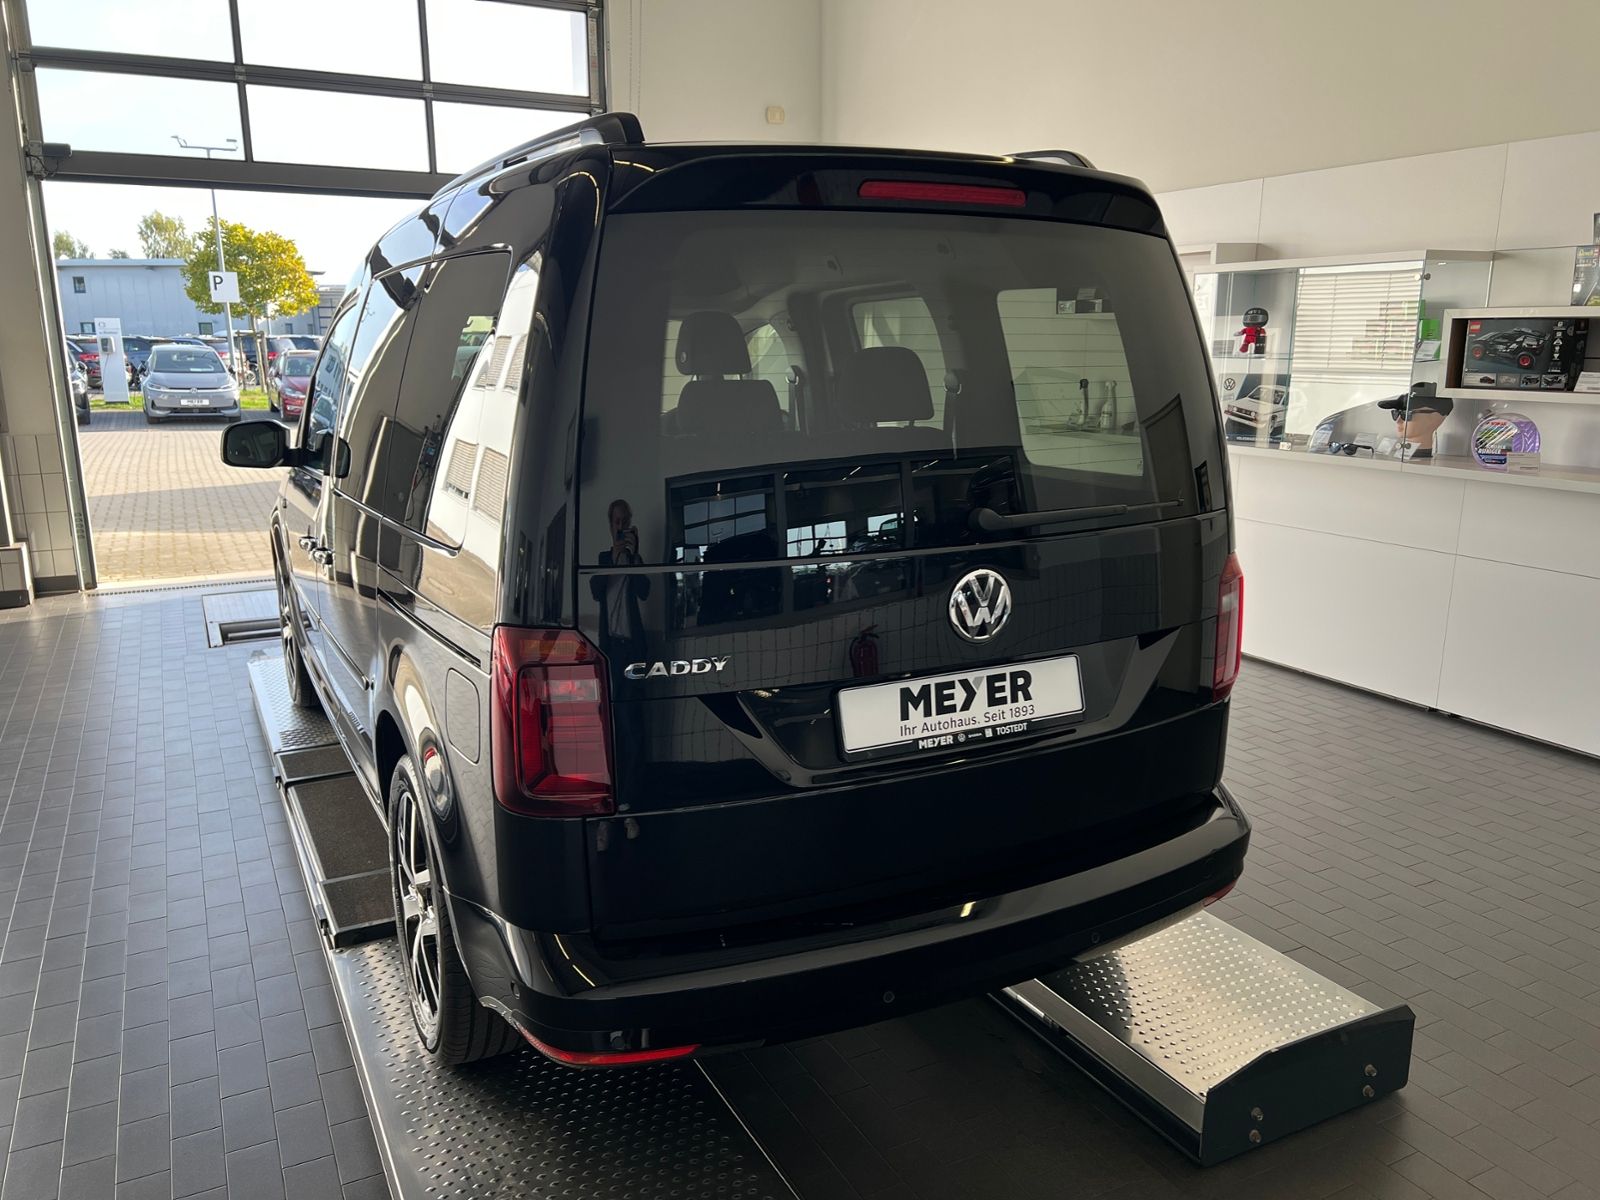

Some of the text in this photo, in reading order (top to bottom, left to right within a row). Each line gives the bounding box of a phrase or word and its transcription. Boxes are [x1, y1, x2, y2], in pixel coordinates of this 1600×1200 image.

[213, 275, 223, 291] P
[624, 655, 731, 680] CADDY
[899, 669, 1033, 722] MEYER
[900, 725, 917, 737] Ihr
[921, 716, 981, 734] Autohaus.
[984, 709, 1006, 723] Seit
[1010, 704, 1035, 719] 1893
[918, 735, 954, 750] MEYER
[996, 723, 1028, 736] TOSTEDT
